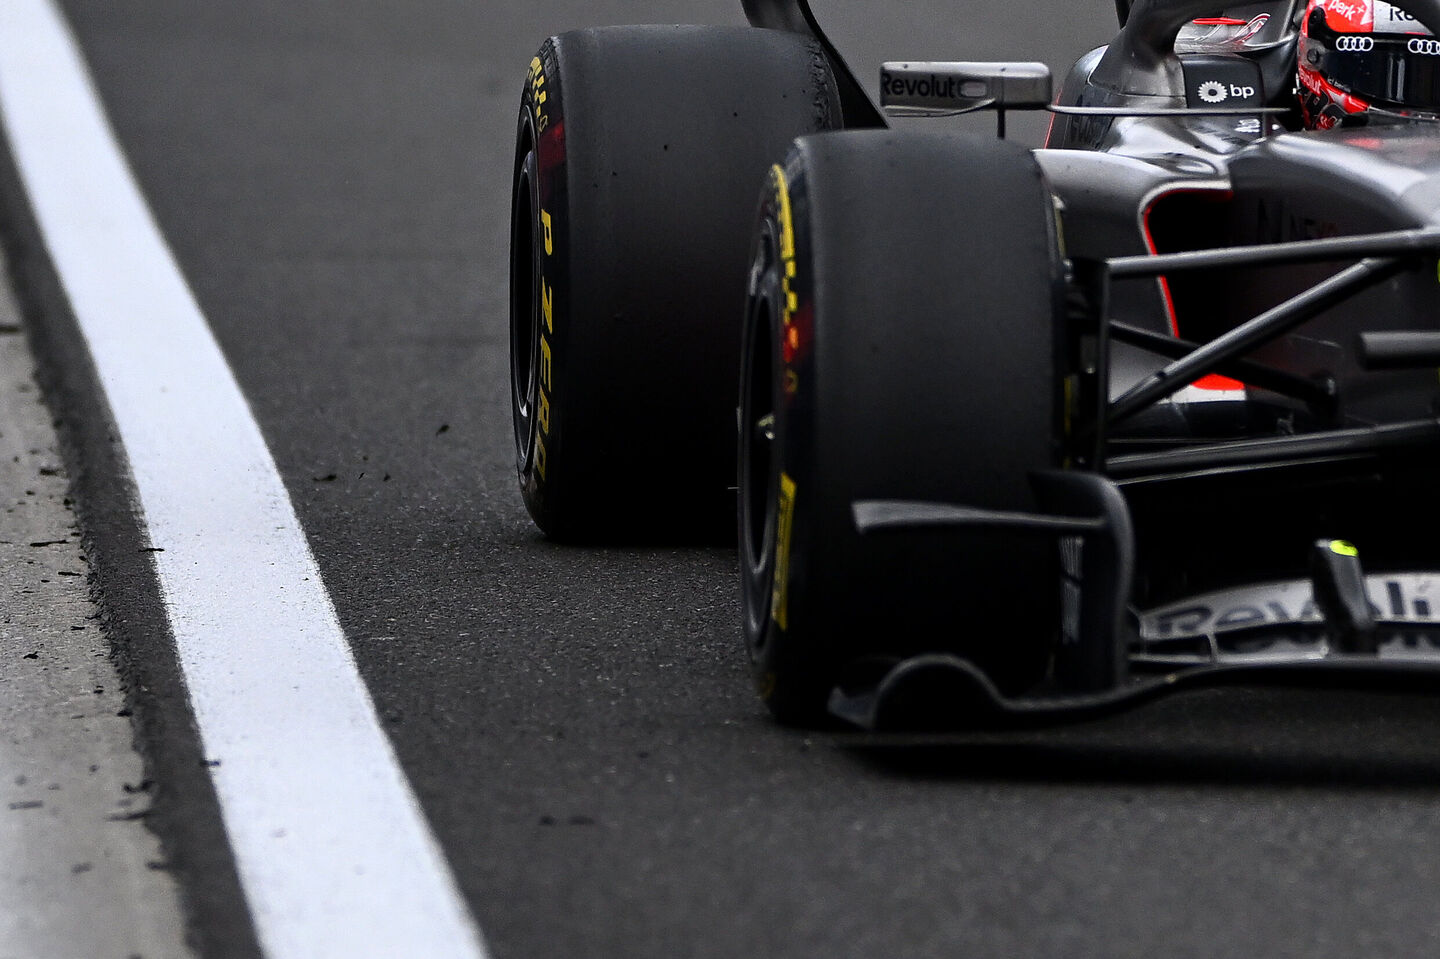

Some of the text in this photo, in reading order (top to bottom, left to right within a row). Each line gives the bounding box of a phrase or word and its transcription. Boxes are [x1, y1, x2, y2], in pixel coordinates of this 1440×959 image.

[881, 72, 957, 99] Revolut
[1229, 83, 1255, 99] bp
[533, 208, 553, 482] P ZERO
